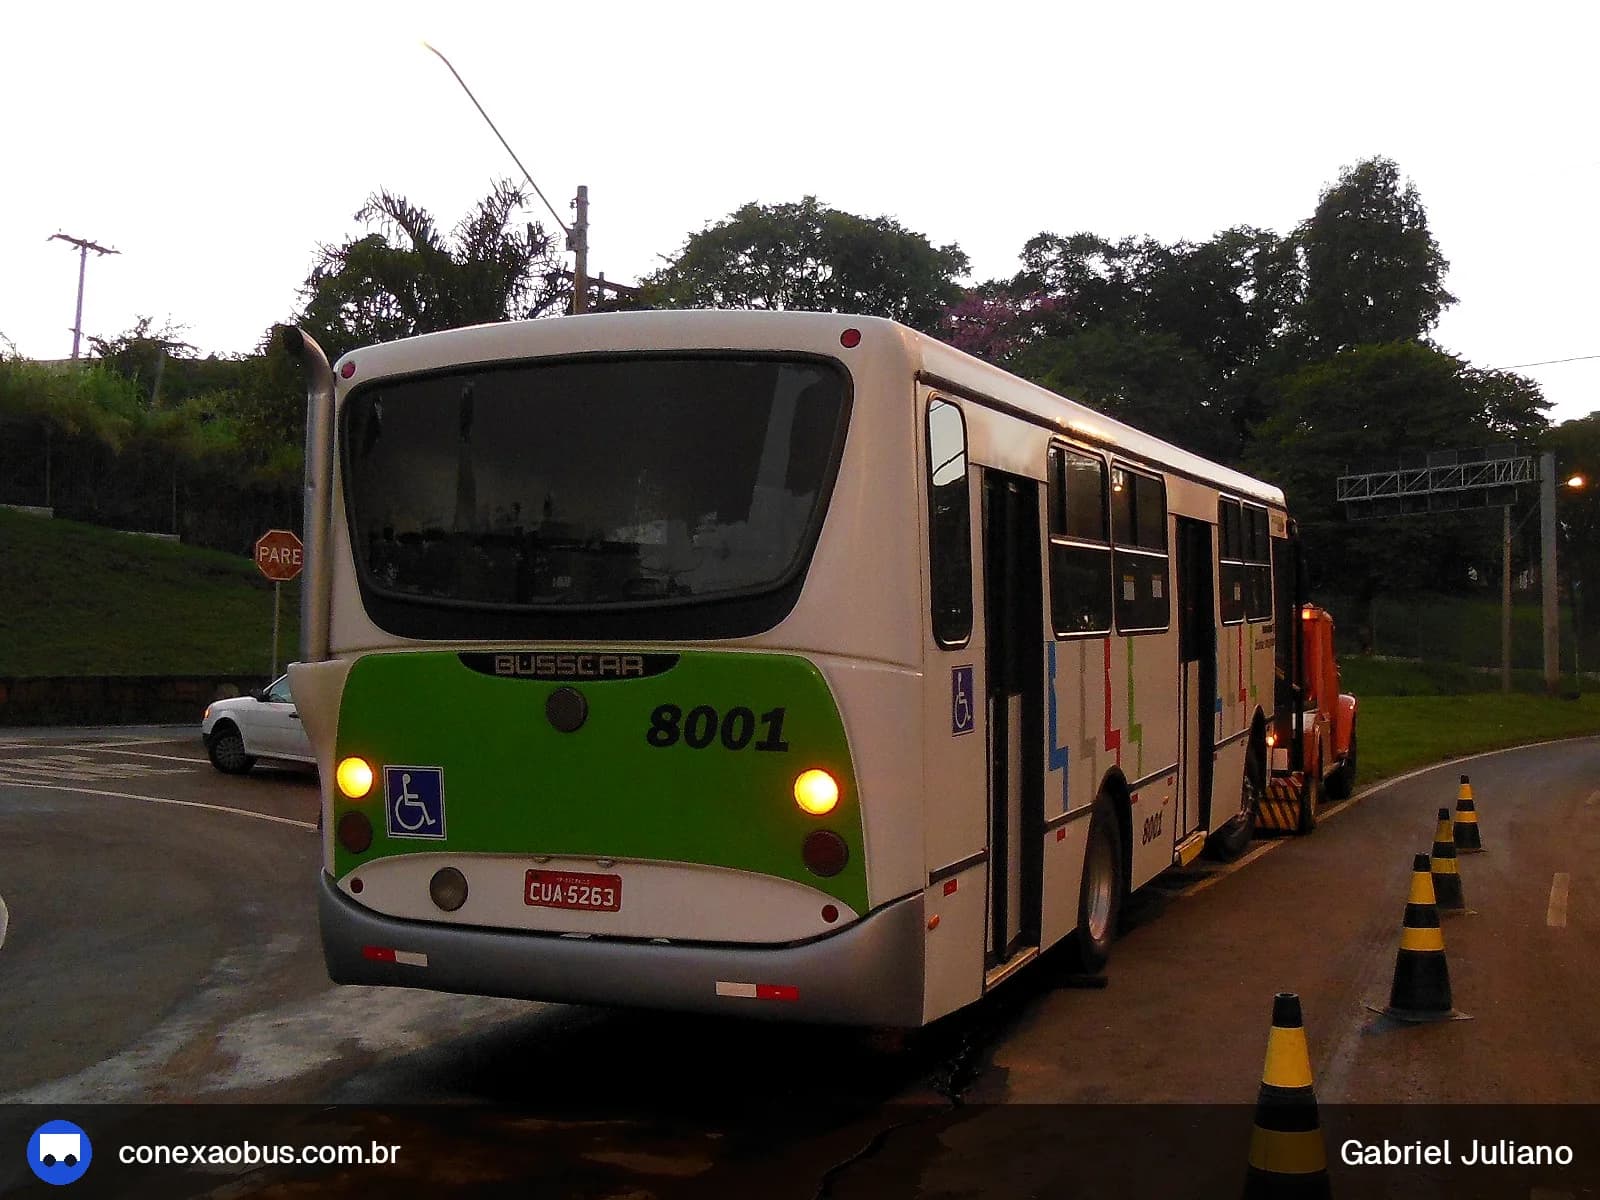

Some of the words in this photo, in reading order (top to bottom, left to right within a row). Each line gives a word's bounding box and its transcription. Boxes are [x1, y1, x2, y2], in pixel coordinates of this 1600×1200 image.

[260, 546, 302, 565] PARE
[495, 655, 643, 675] BUSSCAR
[647, 704, 789, 752] 8001
[1142, 810, 1163, 846] 8001
